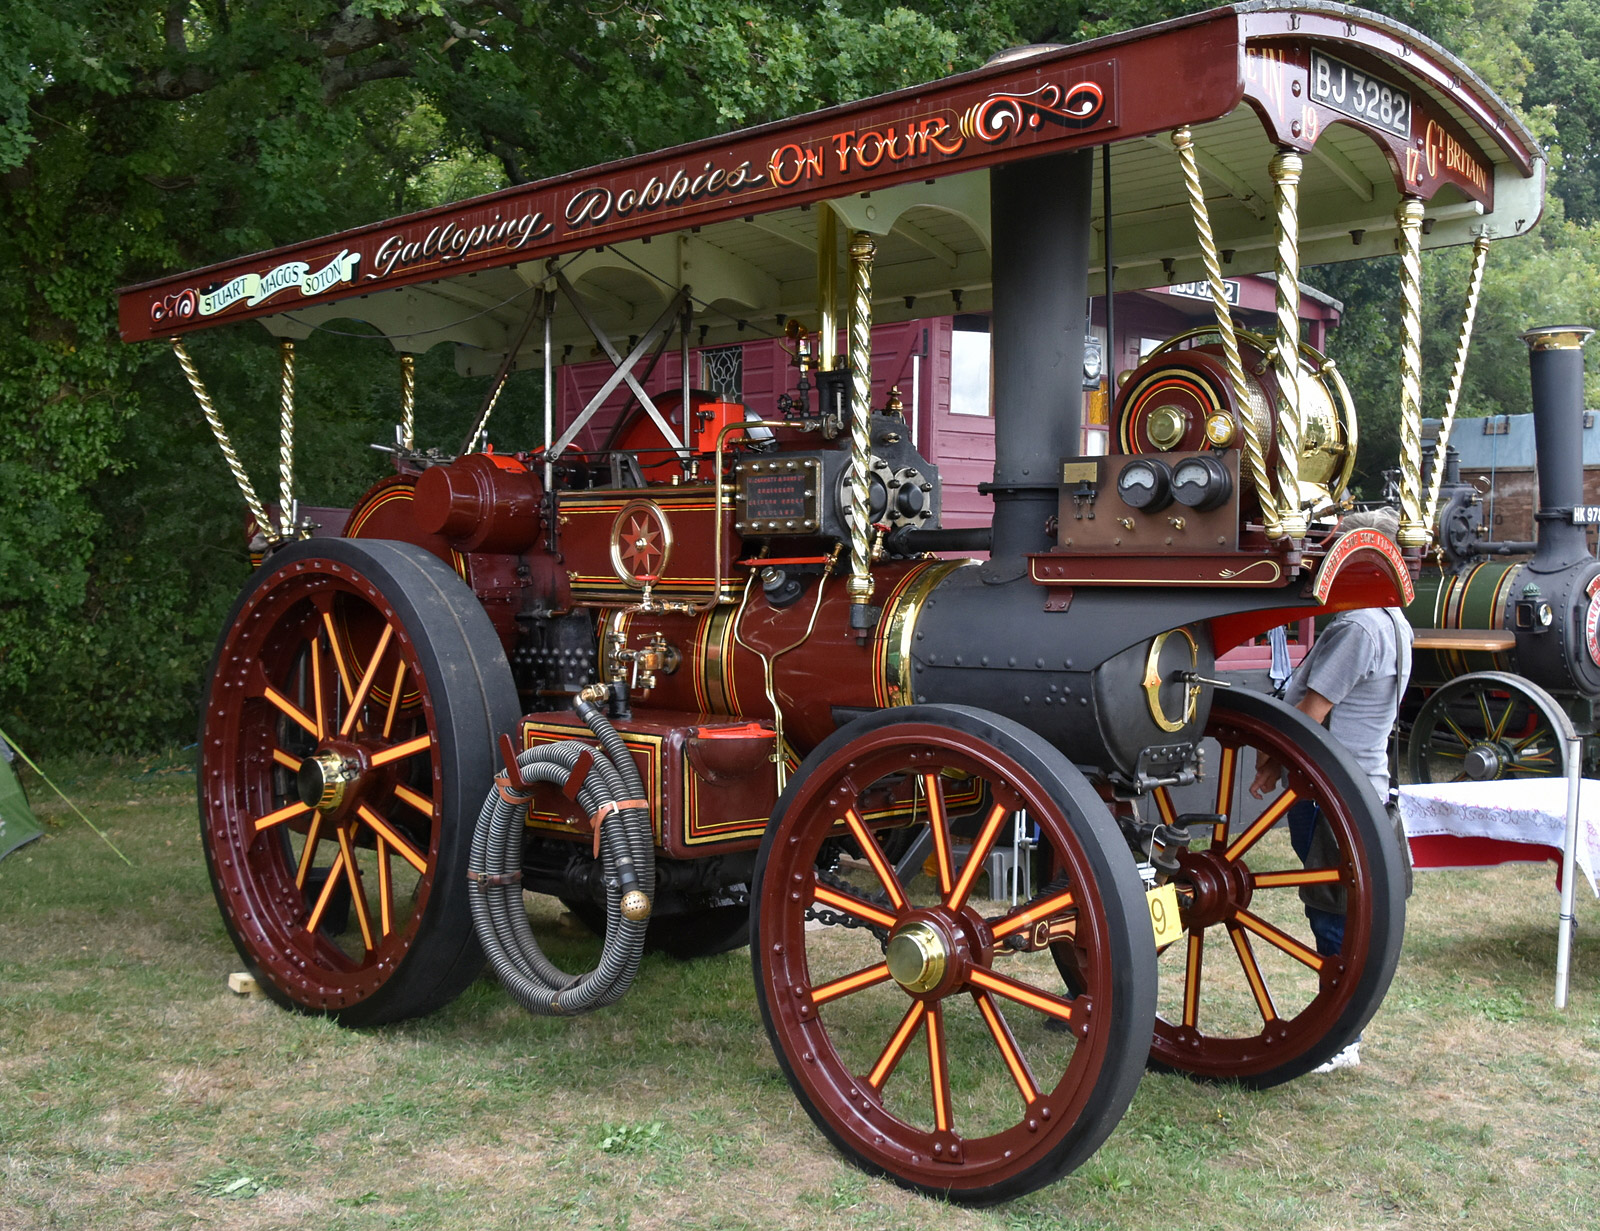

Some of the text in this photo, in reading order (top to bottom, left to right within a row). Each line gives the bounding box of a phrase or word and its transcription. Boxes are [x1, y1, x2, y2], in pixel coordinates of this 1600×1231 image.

[1317, 57, 1346, 103] BJ
[1352, 72, 1406, 131] 3282
[1301, 104, 1319, 140] 19
[1406, 146, 1420, 183] 17
[1446, 133, 1487, 194] BRITAIN
[362, 211, 555, 280] Galloping
[565, 161, 767, 228] Dobbies
[832, 117, 966, 173] TOUR
[204, 259, 342, 312] STUART MAGGS SOTON
[1574, 506, 1585, 522] HK
[1151, 898, 1167, 935] 9
